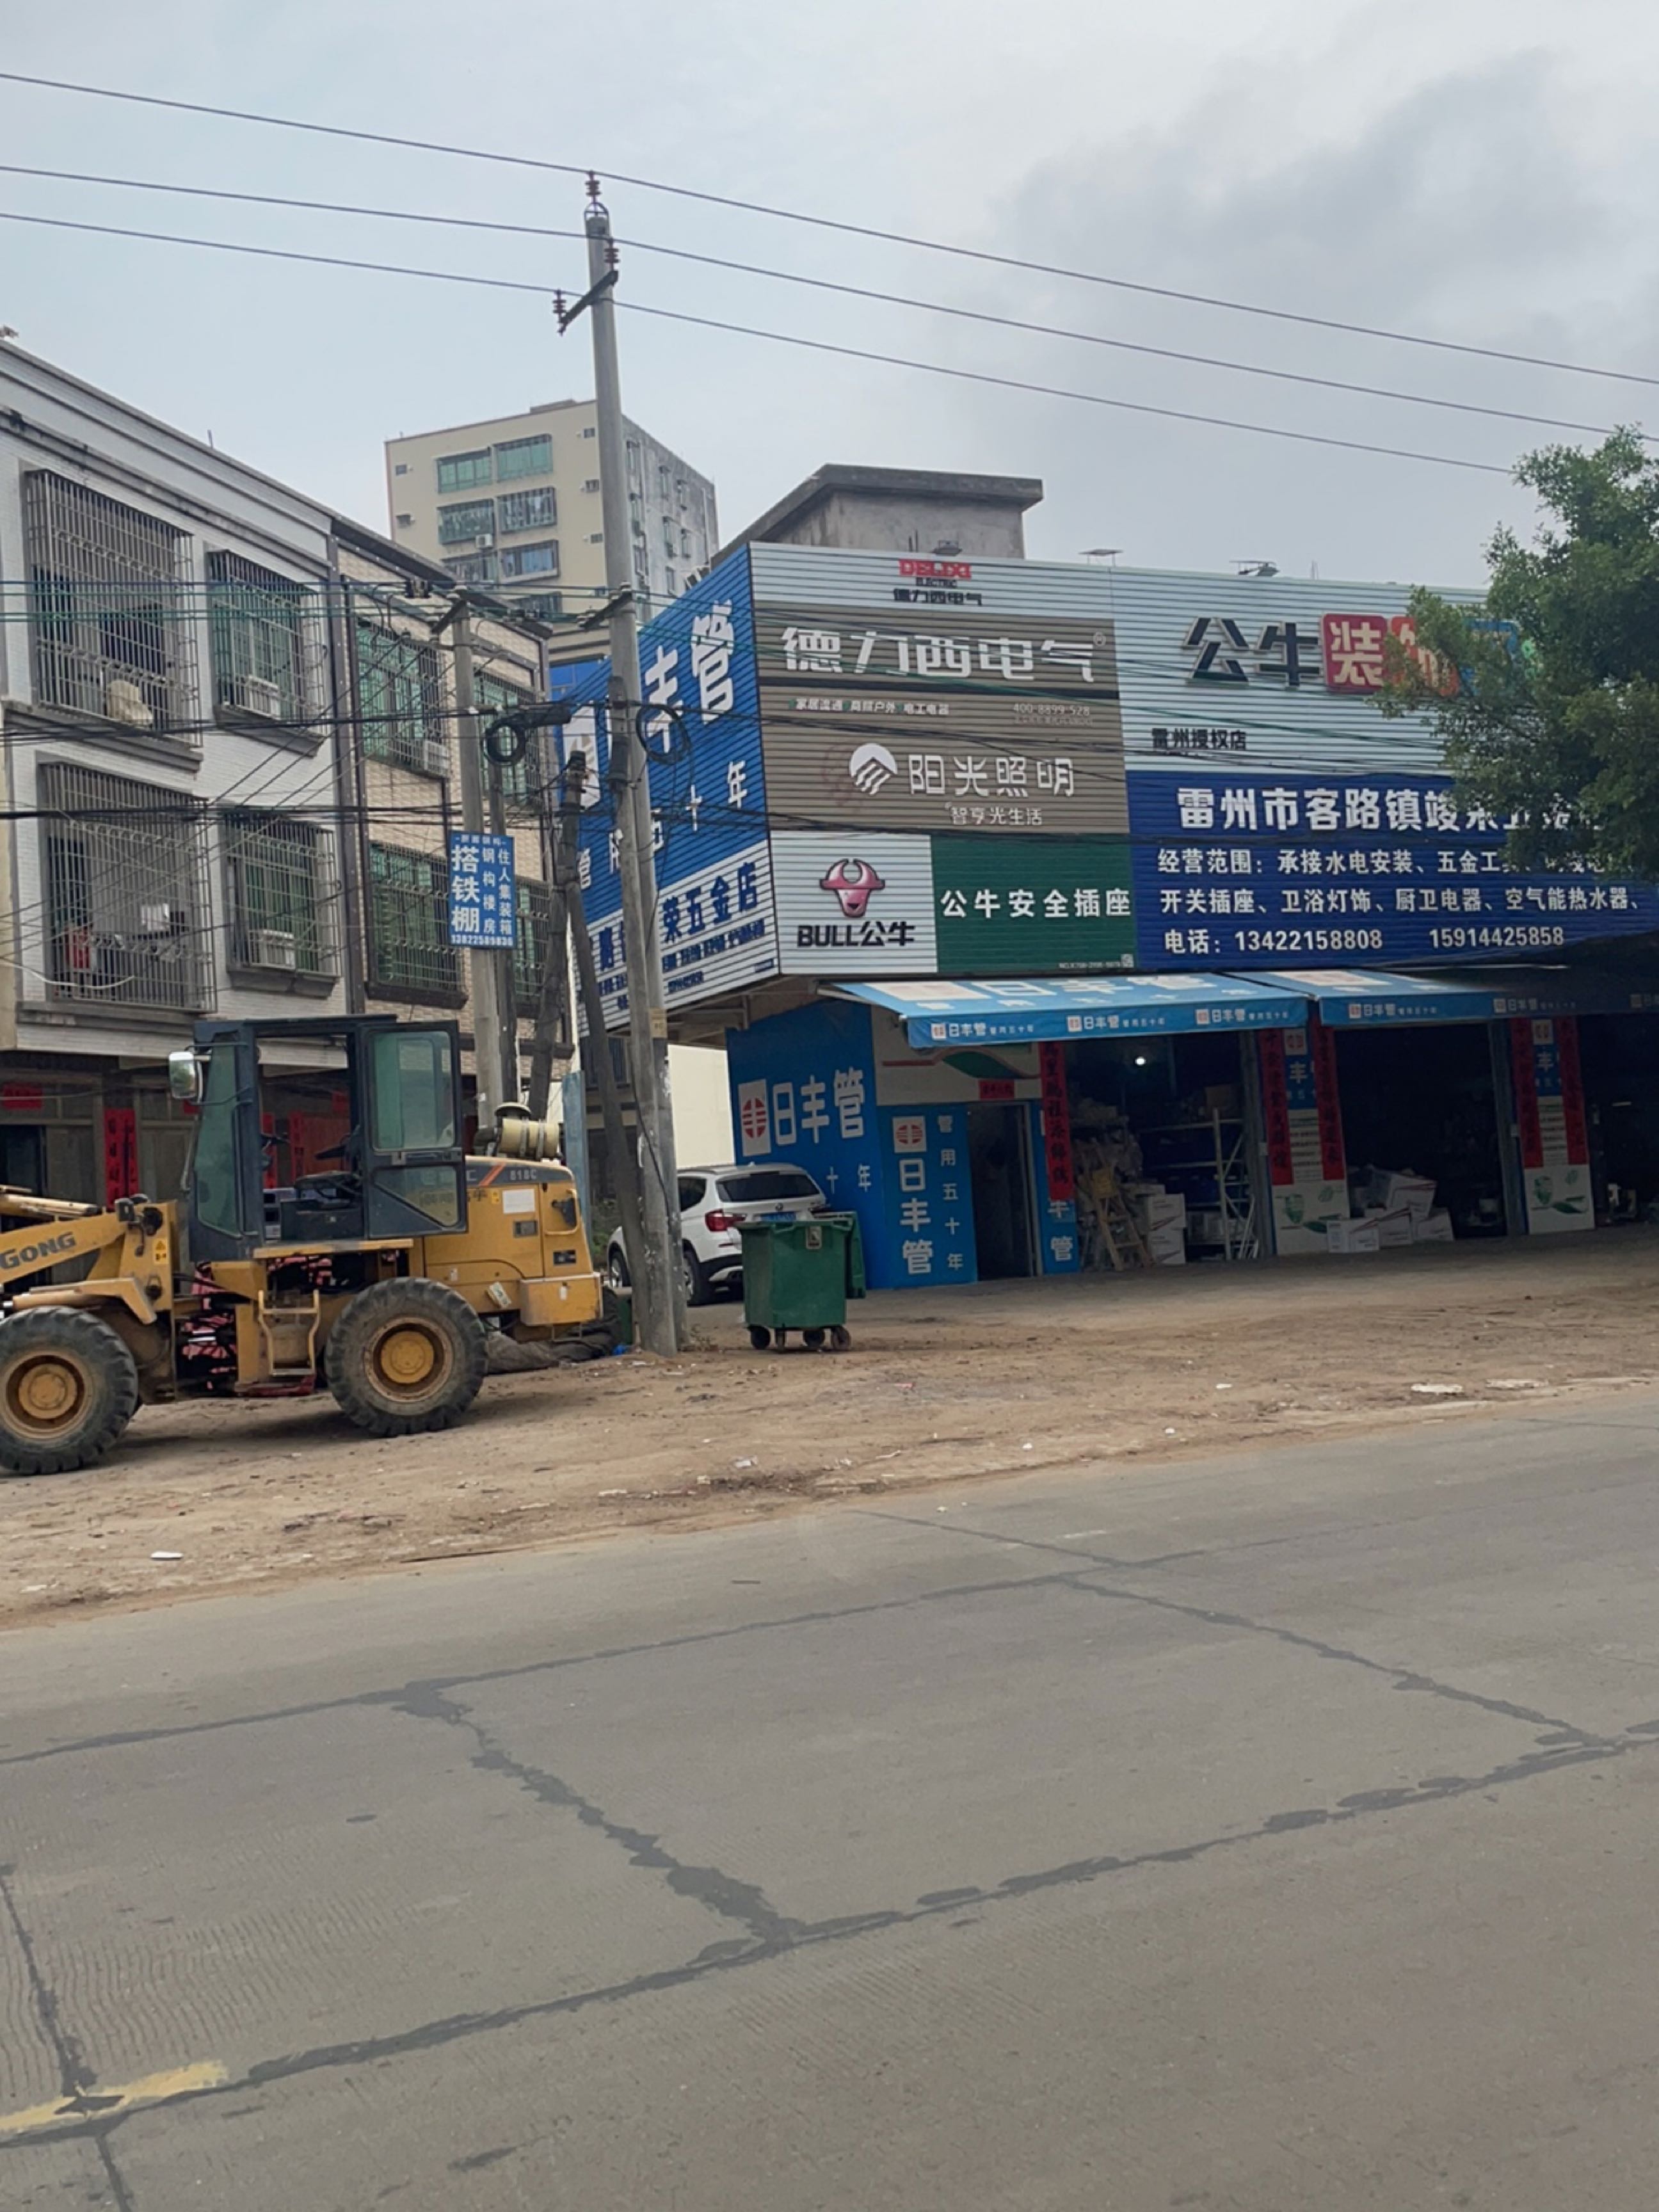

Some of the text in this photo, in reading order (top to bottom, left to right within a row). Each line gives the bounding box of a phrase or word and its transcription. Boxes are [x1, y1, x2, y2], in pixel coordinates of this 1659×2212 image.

[781, 625, 1094, 682] 德力西电气
[1152, 728, 1247, 752] 雷州授权店
[908, 754, 1075, 797] 阳光照明
[451, 844, 480, 933] 搭铁棚
[498, 848, 512, 935] 住人集装箱
[940, 888, 1132, 919] 公牛安全插座
[796, 920, 916, 948] BULL公牛
[1430, 926, 1565, 948] 15914425858
[773, 1066, 866, 1146] 日丰管
[899, 1158, 933, 1276] 日丰管
[937, 1114, 965, 1271] 管用五十年
[1, 1231, 77, 1269] GONG
